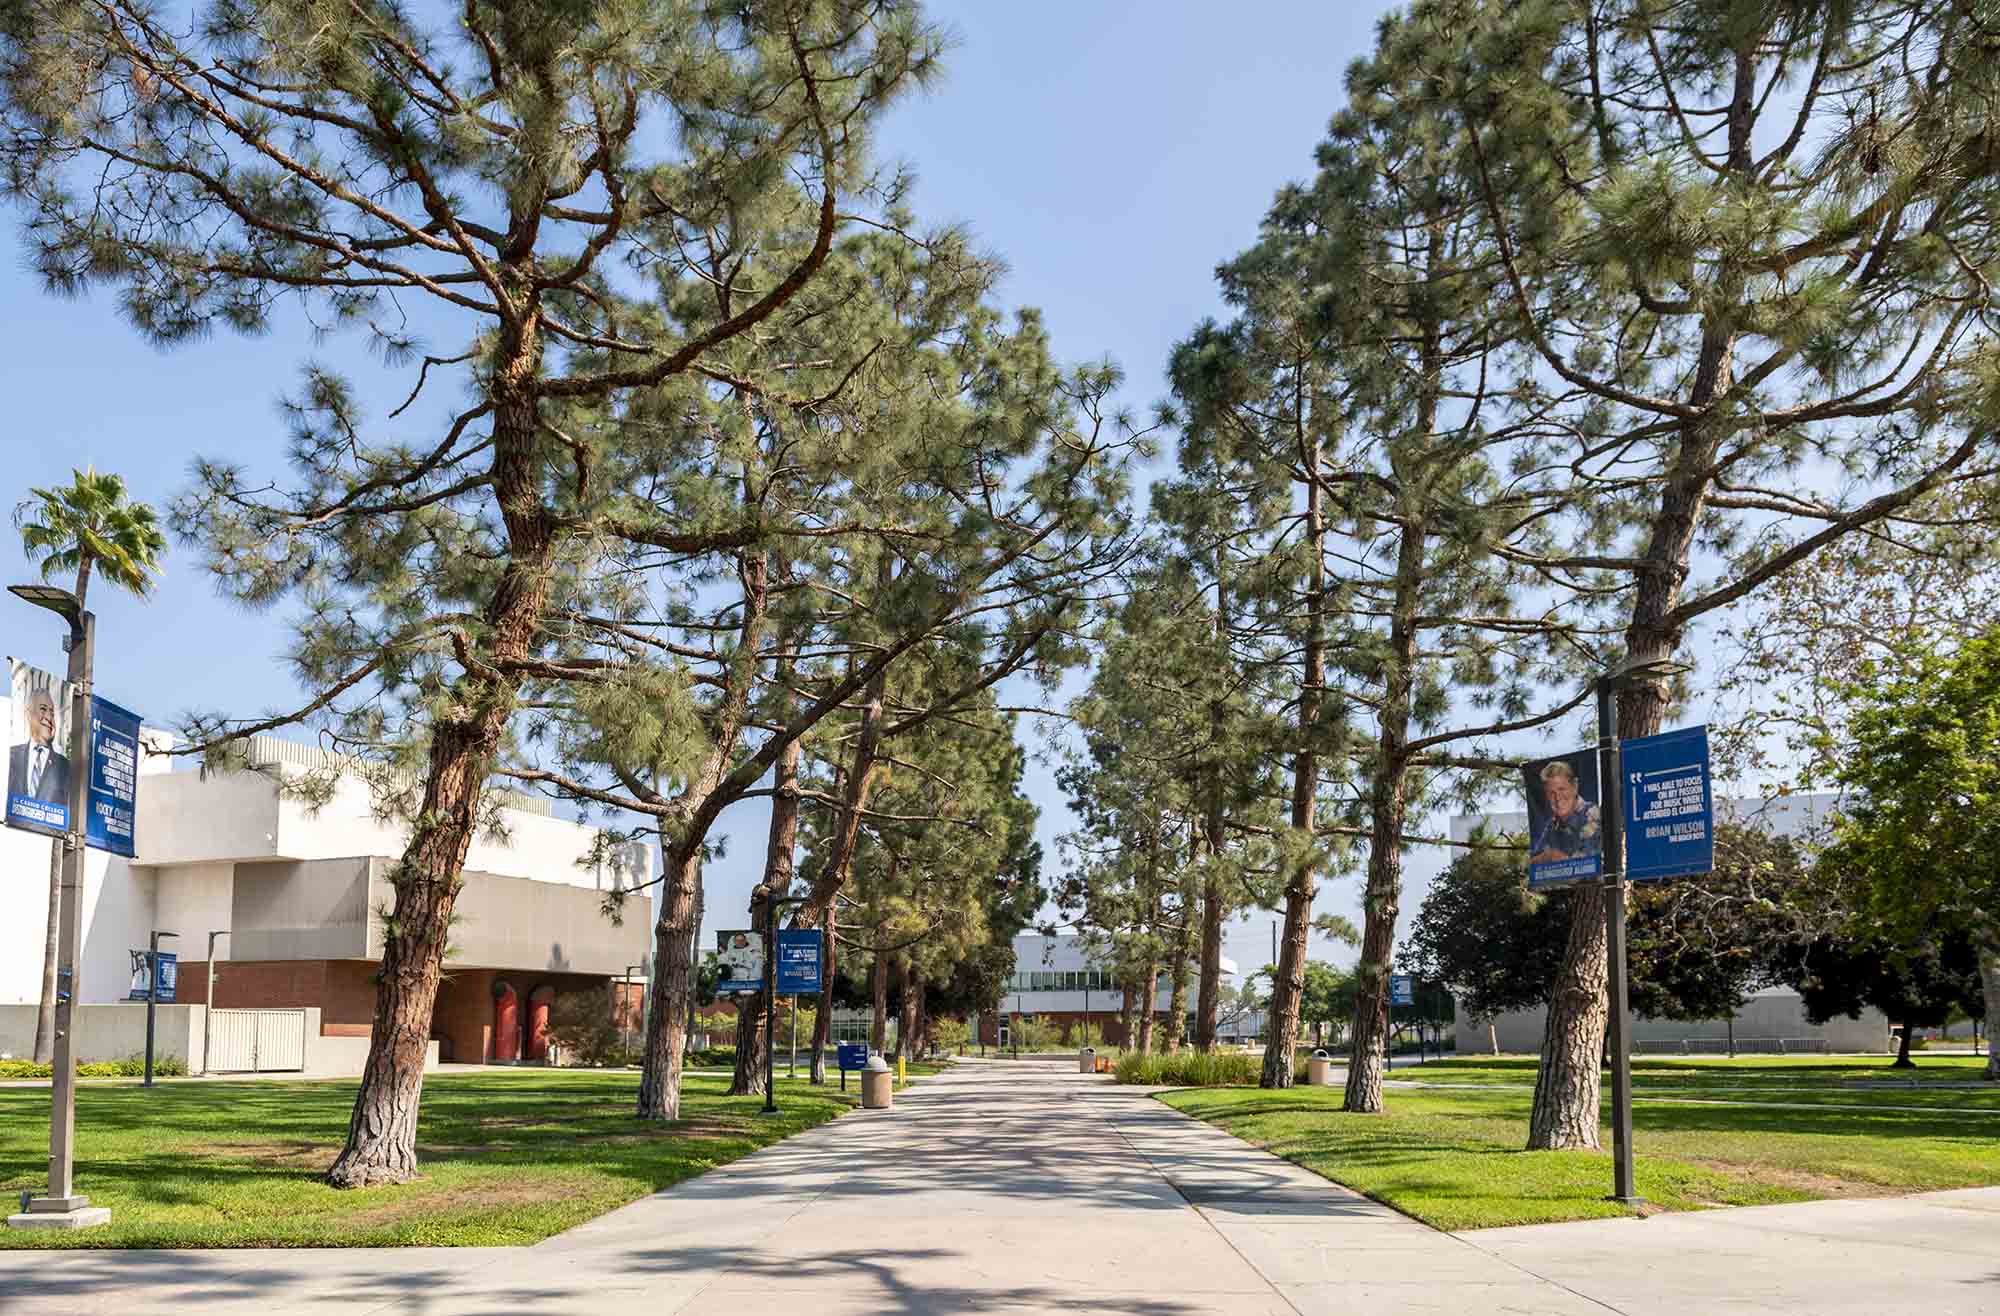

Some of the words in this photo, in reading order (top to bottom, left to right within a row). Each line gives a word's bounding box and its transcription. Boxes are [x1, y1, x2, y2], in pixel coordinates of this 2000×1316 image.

[1647, 782, 1661, 792] WAS
[1662, 780, 1675, 790] ABLE
[1676, 779, 1684, 788] TO
[1684, 776, 1703, 786] FOCUS
[1658, 791, 1668, 800] ON
[1668, 789, 1678, 798] MY
[1650, 801, 1663, 810] FOR
[1682, 795, 1701, 805] WHEN
[1643, 808, 1671, 820] ATTENDED
[1671, 807, 1678, 816] EL
[1646, 824, 1671, 838] BRIAN
[1672, 820, 1705, 836] WILSON
